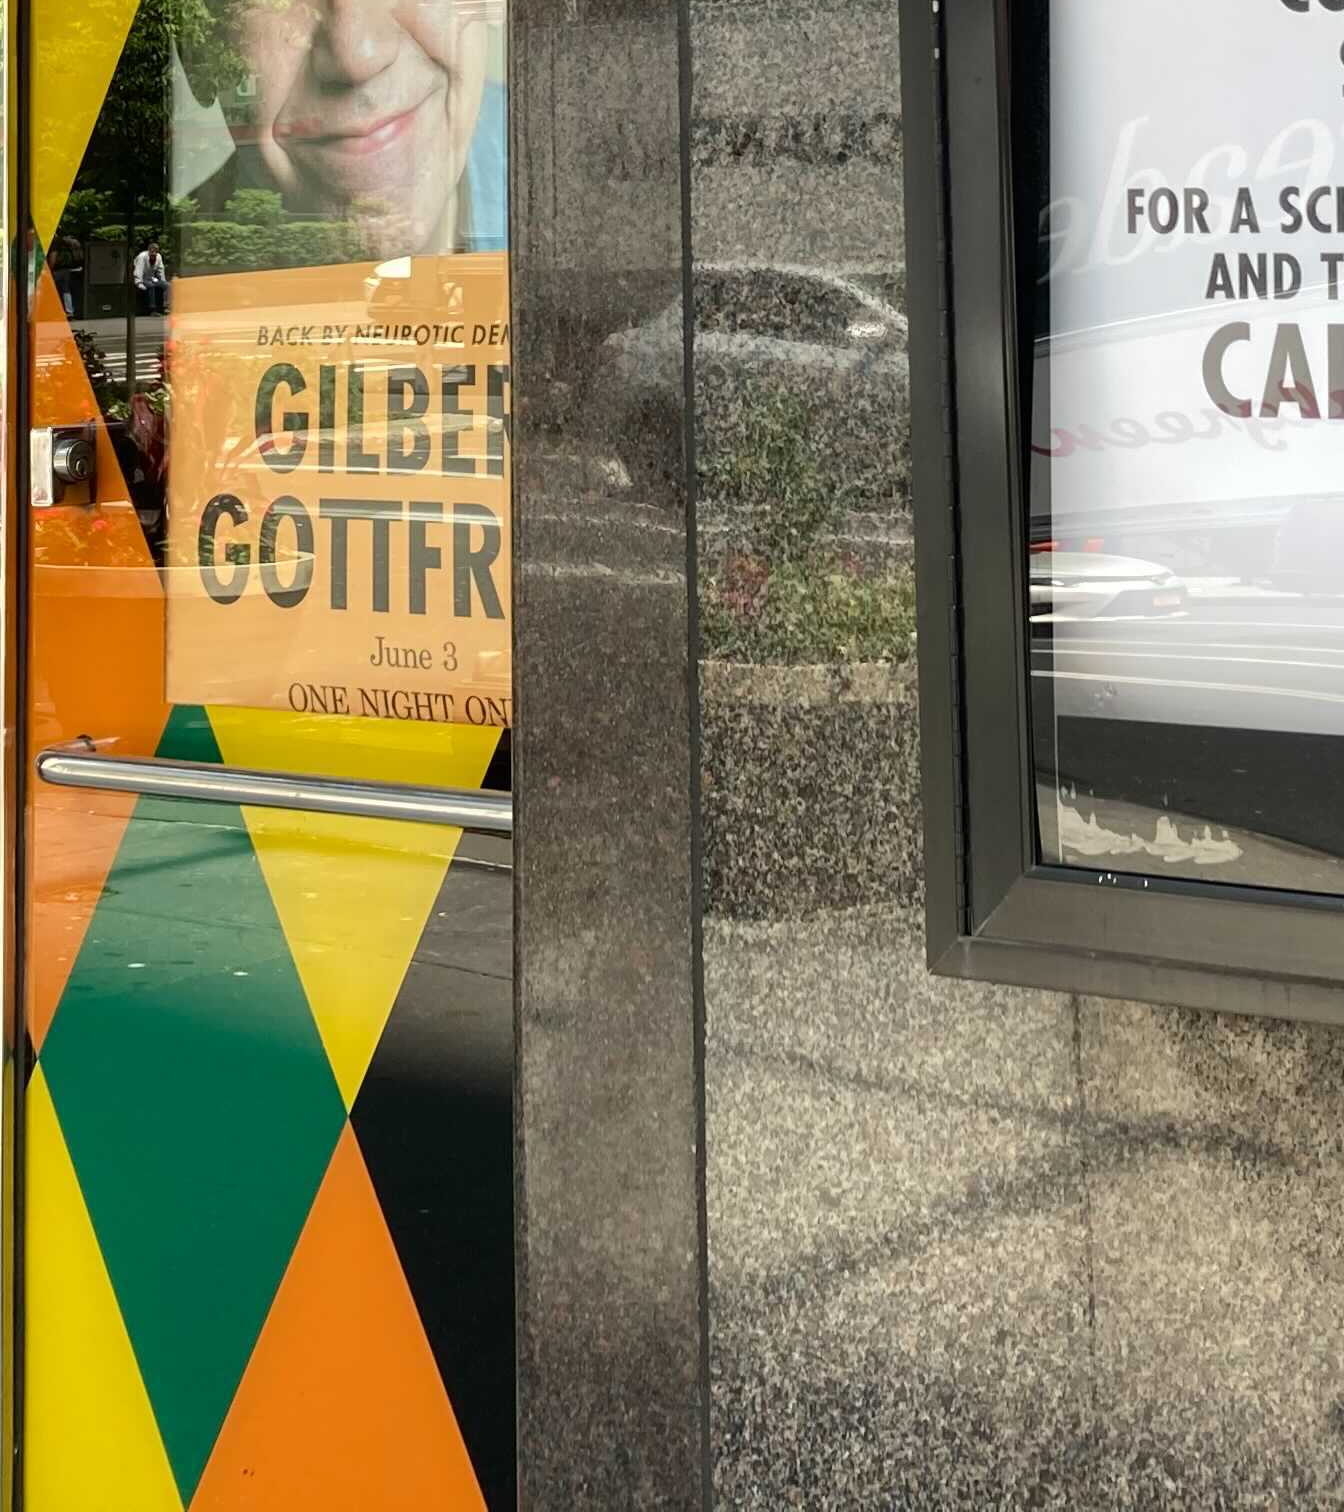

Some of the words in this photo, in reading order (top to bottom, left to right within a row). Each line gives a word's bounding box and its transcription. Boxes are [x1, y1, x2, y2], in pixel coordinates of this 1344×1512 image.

[1126, 187, 1211, 235] FOR
[1229, 186, 1261, 235] A
[1204, 251, 1303, 300] AND
[256, 325, 317, 346] BACK
[321, 324, 350, 346] BY
[354, 323, 466, 346] NEUROTIC
[198, 492, 506, 620] GOTTFR
[370, 636, 433, 670] June
[442, 641, 458, 672] 3
[288, 682, 350, 715] ONE
[359, 687, 454, 723] NIGHT
